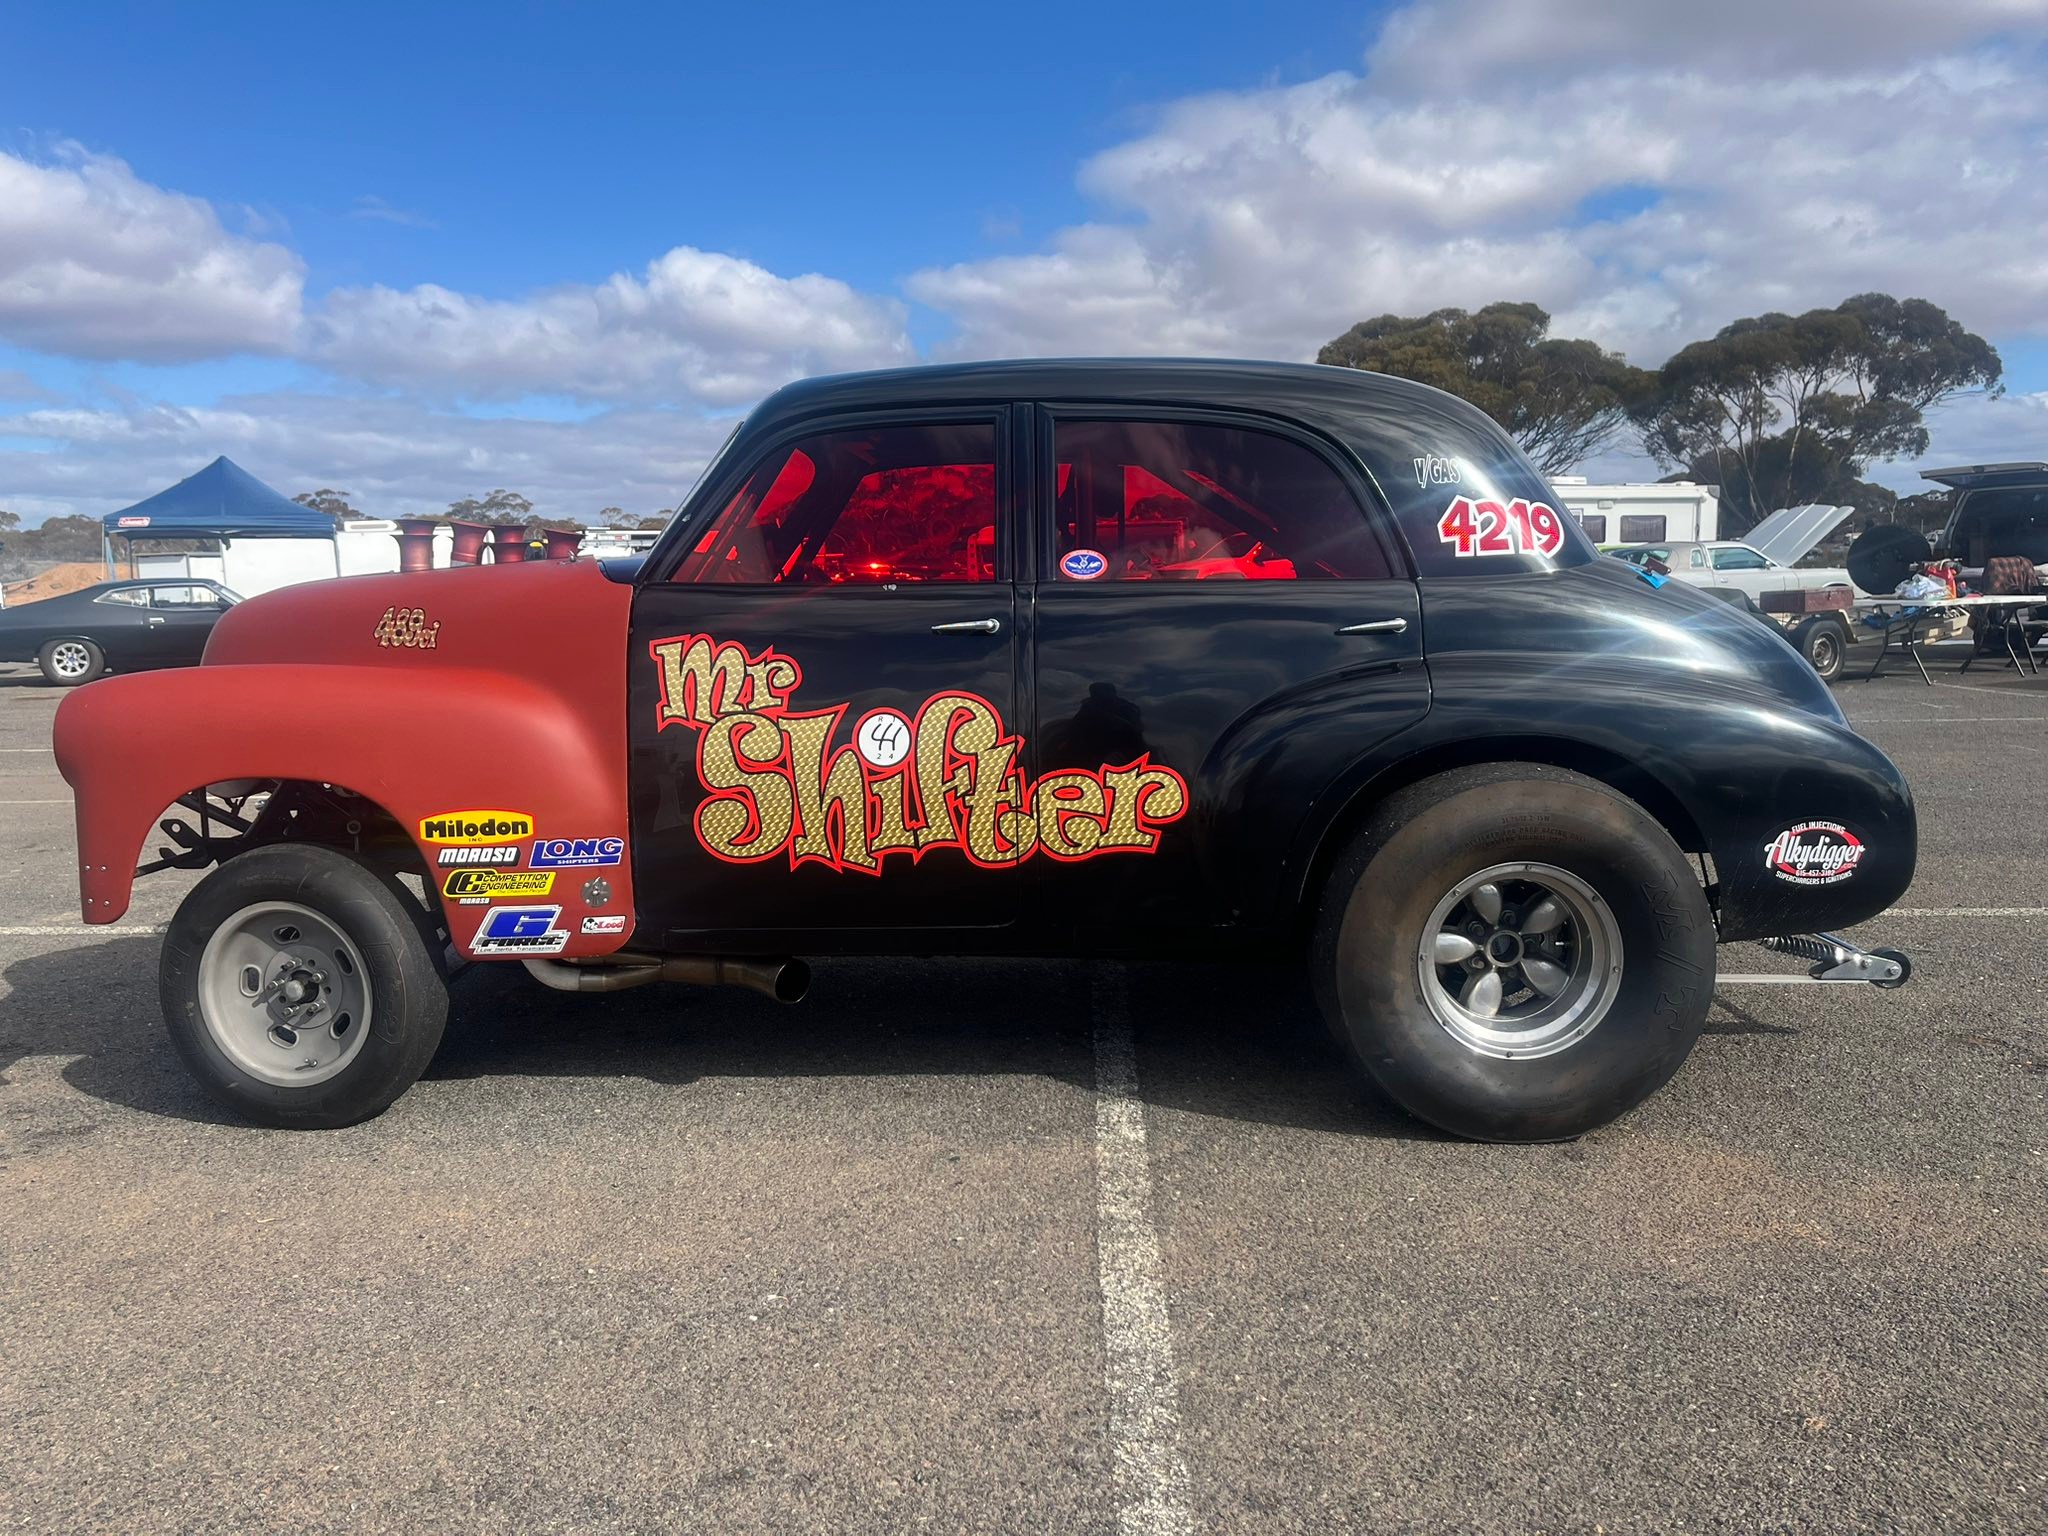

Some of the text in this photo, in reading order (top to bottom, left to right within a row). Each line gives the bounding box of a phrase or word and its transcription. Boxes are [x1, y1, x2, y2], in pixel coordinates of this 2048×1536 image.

[1437, 494, 1565, 559] 4219
[693, 691, 1187, 876] Shifter
[425, 819, 528, 838] Milodon
[1791, 821, 1847, 834] FUEL INJECTIONS
[438, 847, 518, 863] MOROSO
[529, 837, 624, 868] LONG
[1764, 830, 1866, 870] Alkydigger
[479, 881, 547, 891] ENGINEERING
[482, 873, 550, 882] COMPETITION
[1775, 870, 1820, 885] SUPERCHARGERS
